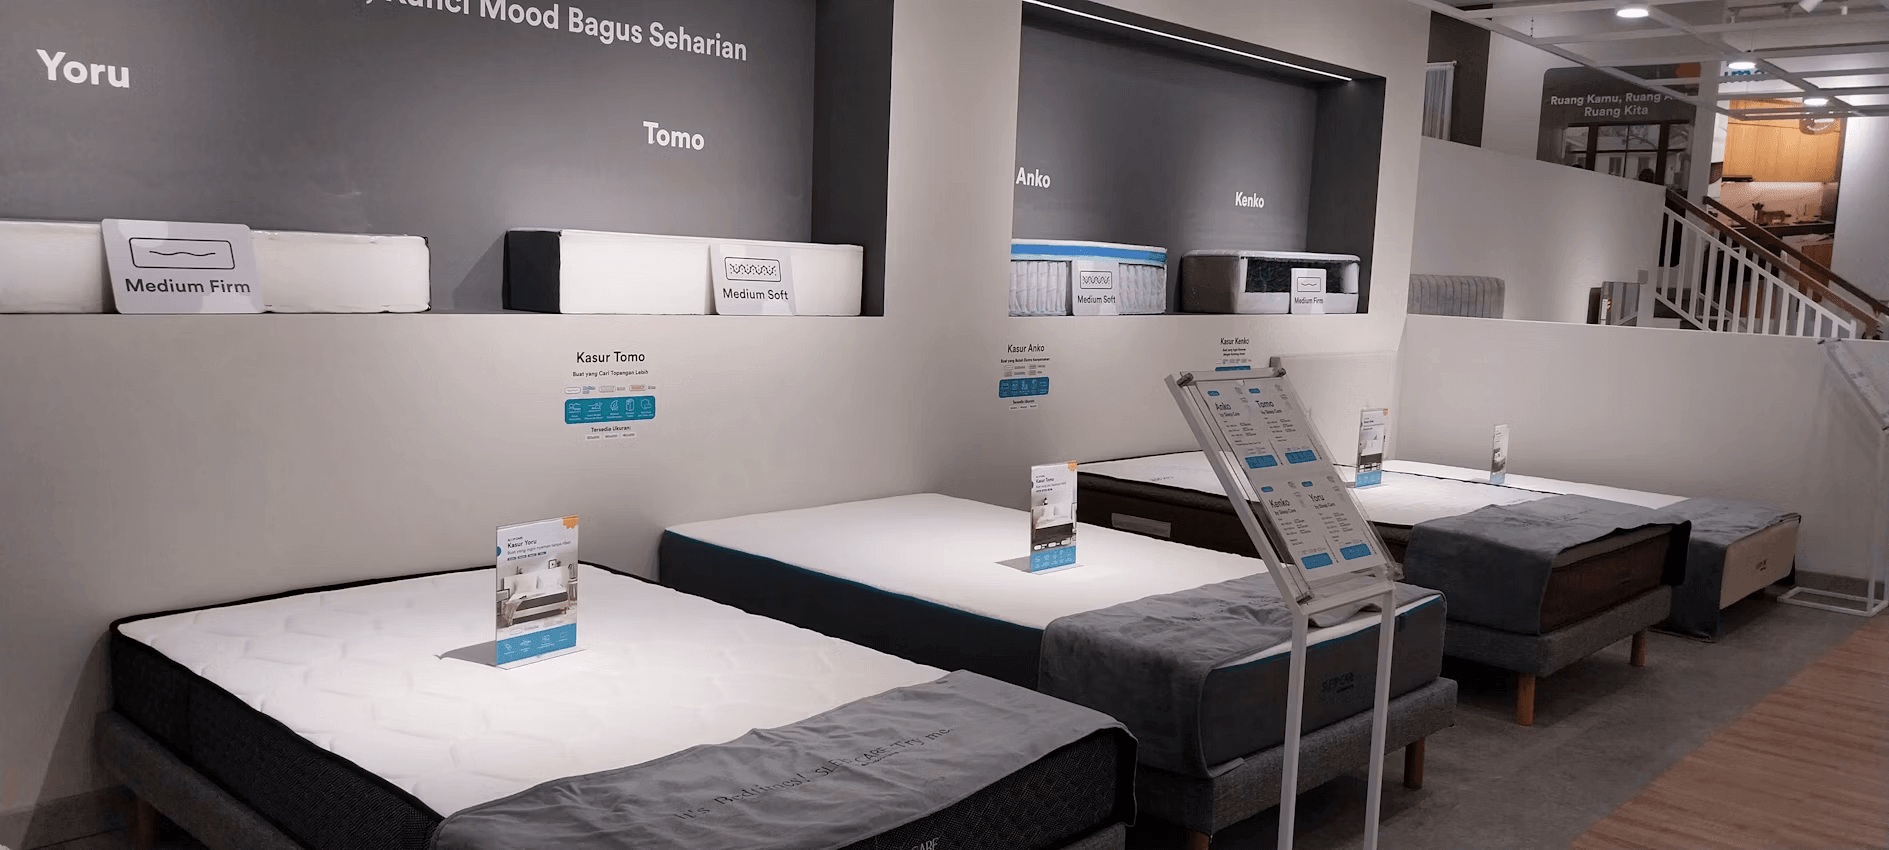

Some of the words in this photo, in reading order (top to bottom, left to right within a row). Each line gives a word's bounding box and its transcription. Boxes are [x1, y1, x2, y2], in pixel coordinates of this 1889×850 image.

[480, 0, 559, 30] Mood
[568, 6, 643, 45] Bagus
[649, 21, 747, 61] Seharian
[36, 48, 130, 88] Yoru
[1550, 95, 1584, 106] Ruang
[1587, 94, 1622, 104] Kamu,
[1625, 92, 1661, 103] Ruang
[1584, 106, 1621, 118] Ruang
[1624, 104, 1649, 116] Kita
[642, 120, 705, 151] Tomo
[1015, 166, 1051, 189] Anko
[1234, 191, 1265, 209] Kenko
[125, 278, 205, 293] Medium
[209, 279, 251, 293] Firm
[722, 287, 765, 300] Medium
[767, 289, 789, 301] Soft
[1077, 295, 1103, 304] Medium
[1103, 294, 1116, 304] Soft
[1007, 344, 1027, 354] Kasur
[1027, 343, 1045, 353] Anko
[576, 351, 611, 364] Kasur
[613, 351, 646, 363] Tomo
[1214, 402, 1232, 411] Anko
[1255, 400, 1275, 409] Tomo
[1268, 498, 1290, 508] Kenko
[1308, 493, 1325, 502] Yoru
[507, 541, 523, 549] Kasur
